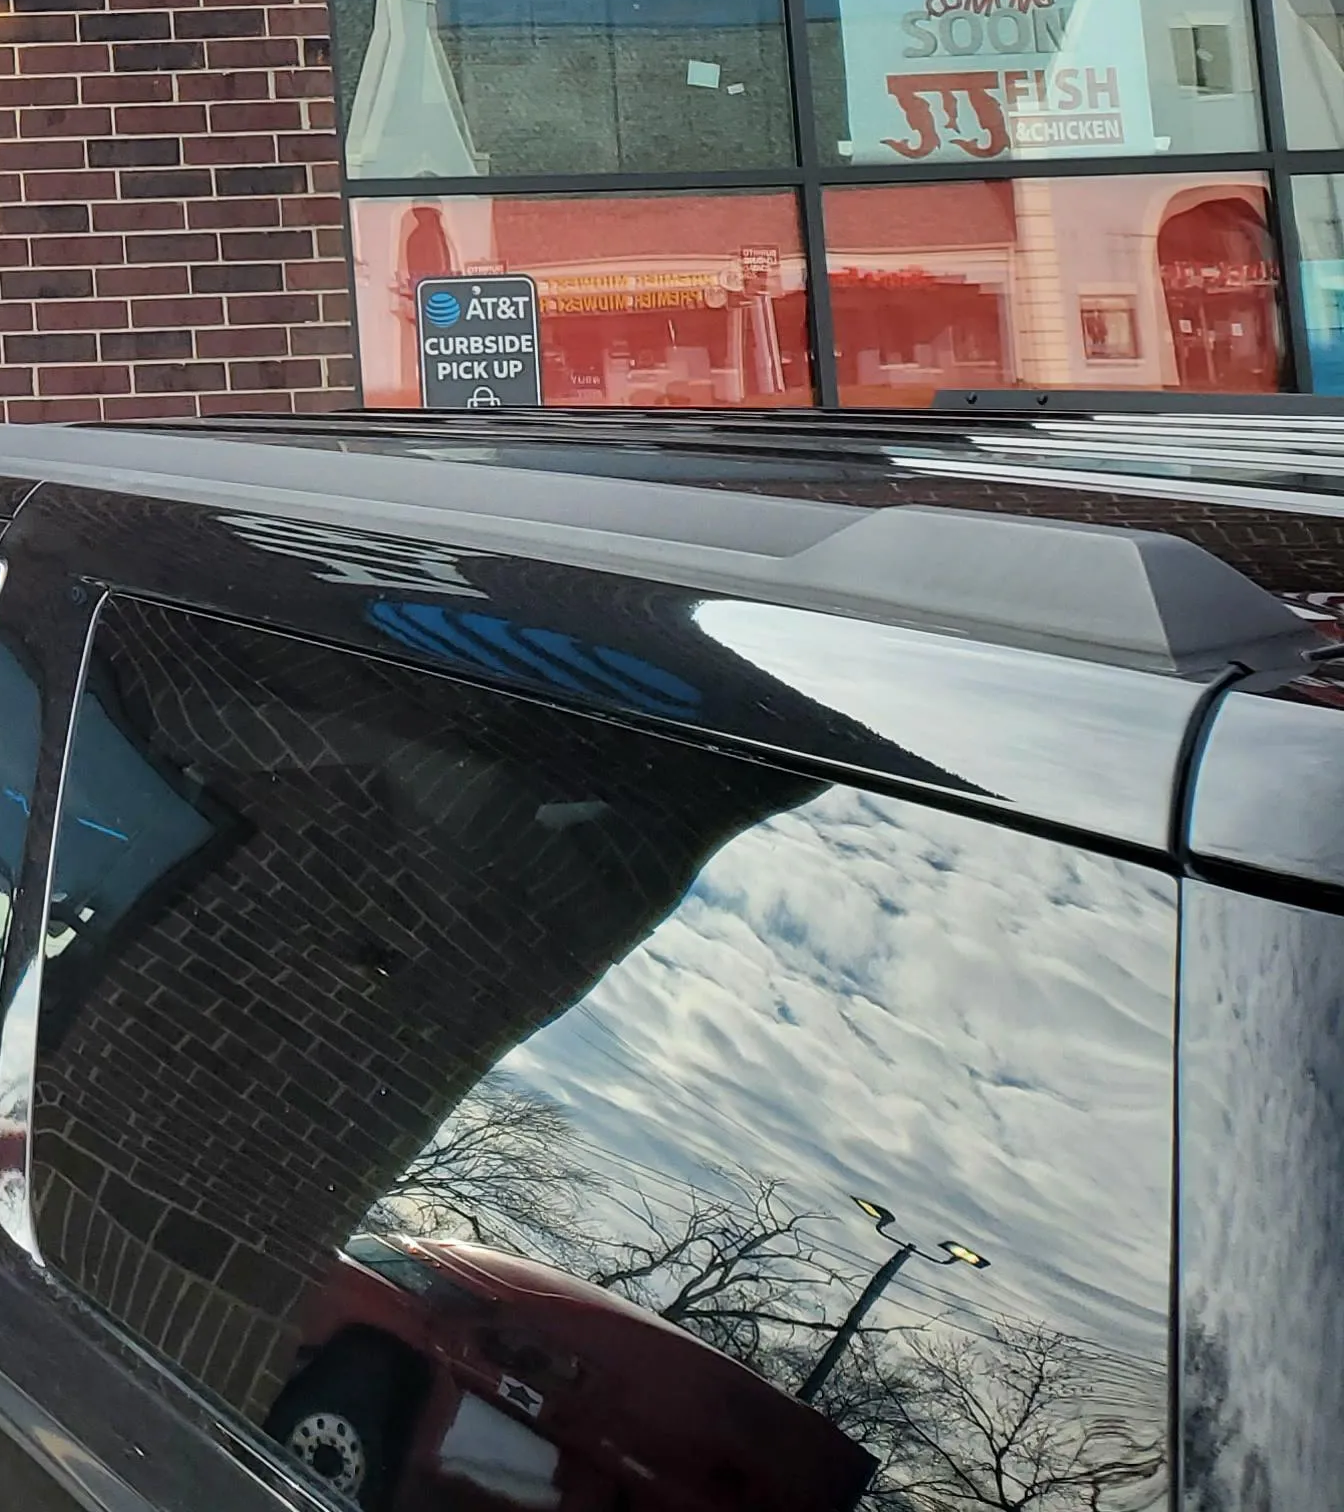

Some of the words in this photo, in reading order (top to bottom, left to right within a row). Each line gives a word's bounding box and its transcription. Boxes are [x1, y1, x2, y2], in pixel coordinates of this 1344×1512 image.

[901, 5, 1069, 59] SOON
[1004, 66, 1120, 112] FISH
[1015, 118, 1121, 143] &CHICKEN
[465, 296, 530, 321] AT&T
[424, 335, 534, 356] CURBSIDE
[437, 360, 489, 380] PICK
[493, 360, 523, 379] UP
